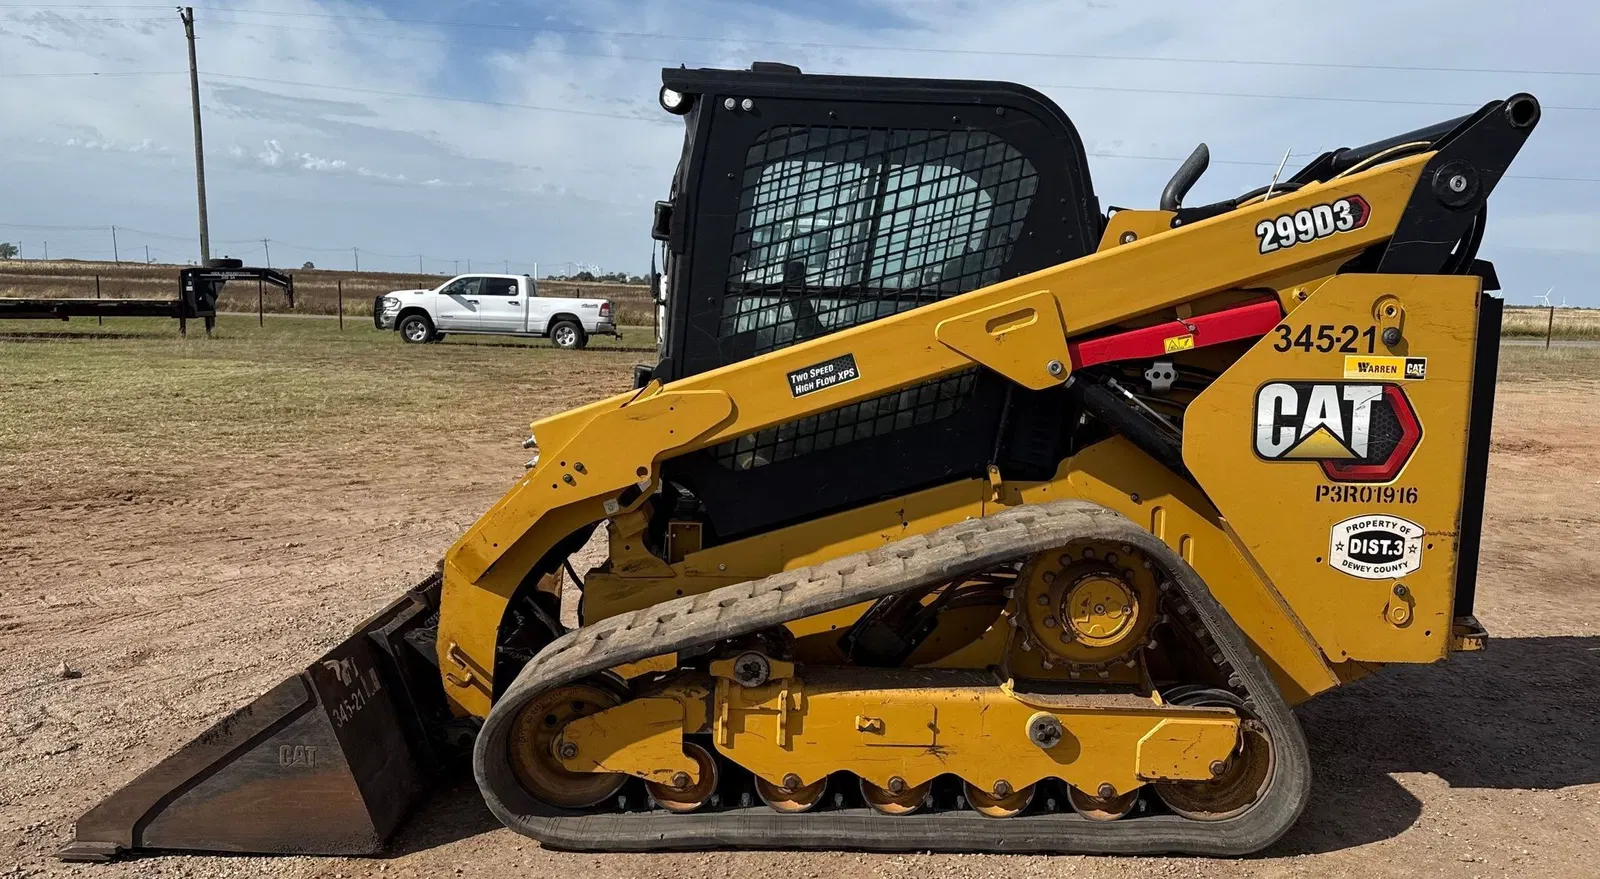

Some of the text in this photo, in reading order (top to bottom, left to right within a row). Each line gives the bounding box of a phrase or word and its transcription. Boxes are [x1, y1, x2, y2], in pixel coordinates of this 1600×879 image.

[1257, 200, 1354, 253] 299D3
[1273, 324, 1376, 353] 345-21
[791, 365, 834, 384] TWO SPEED
[1358, 362, 1425, 375] WARREN CAT
[795, 368, 855, 394] HIGH FLOW XPS
[1257, 383, 1383, 459] CAT
[1315, 485, 1418, 504] P3R01916
[1346, 520, 1411, 535] PROPERTY OF
[1349, 539, 1403, 555] DIST.3
[1342, 560, 1408, 573] DEWEY COUNTY
[280, 744, 318, 768] CAT
